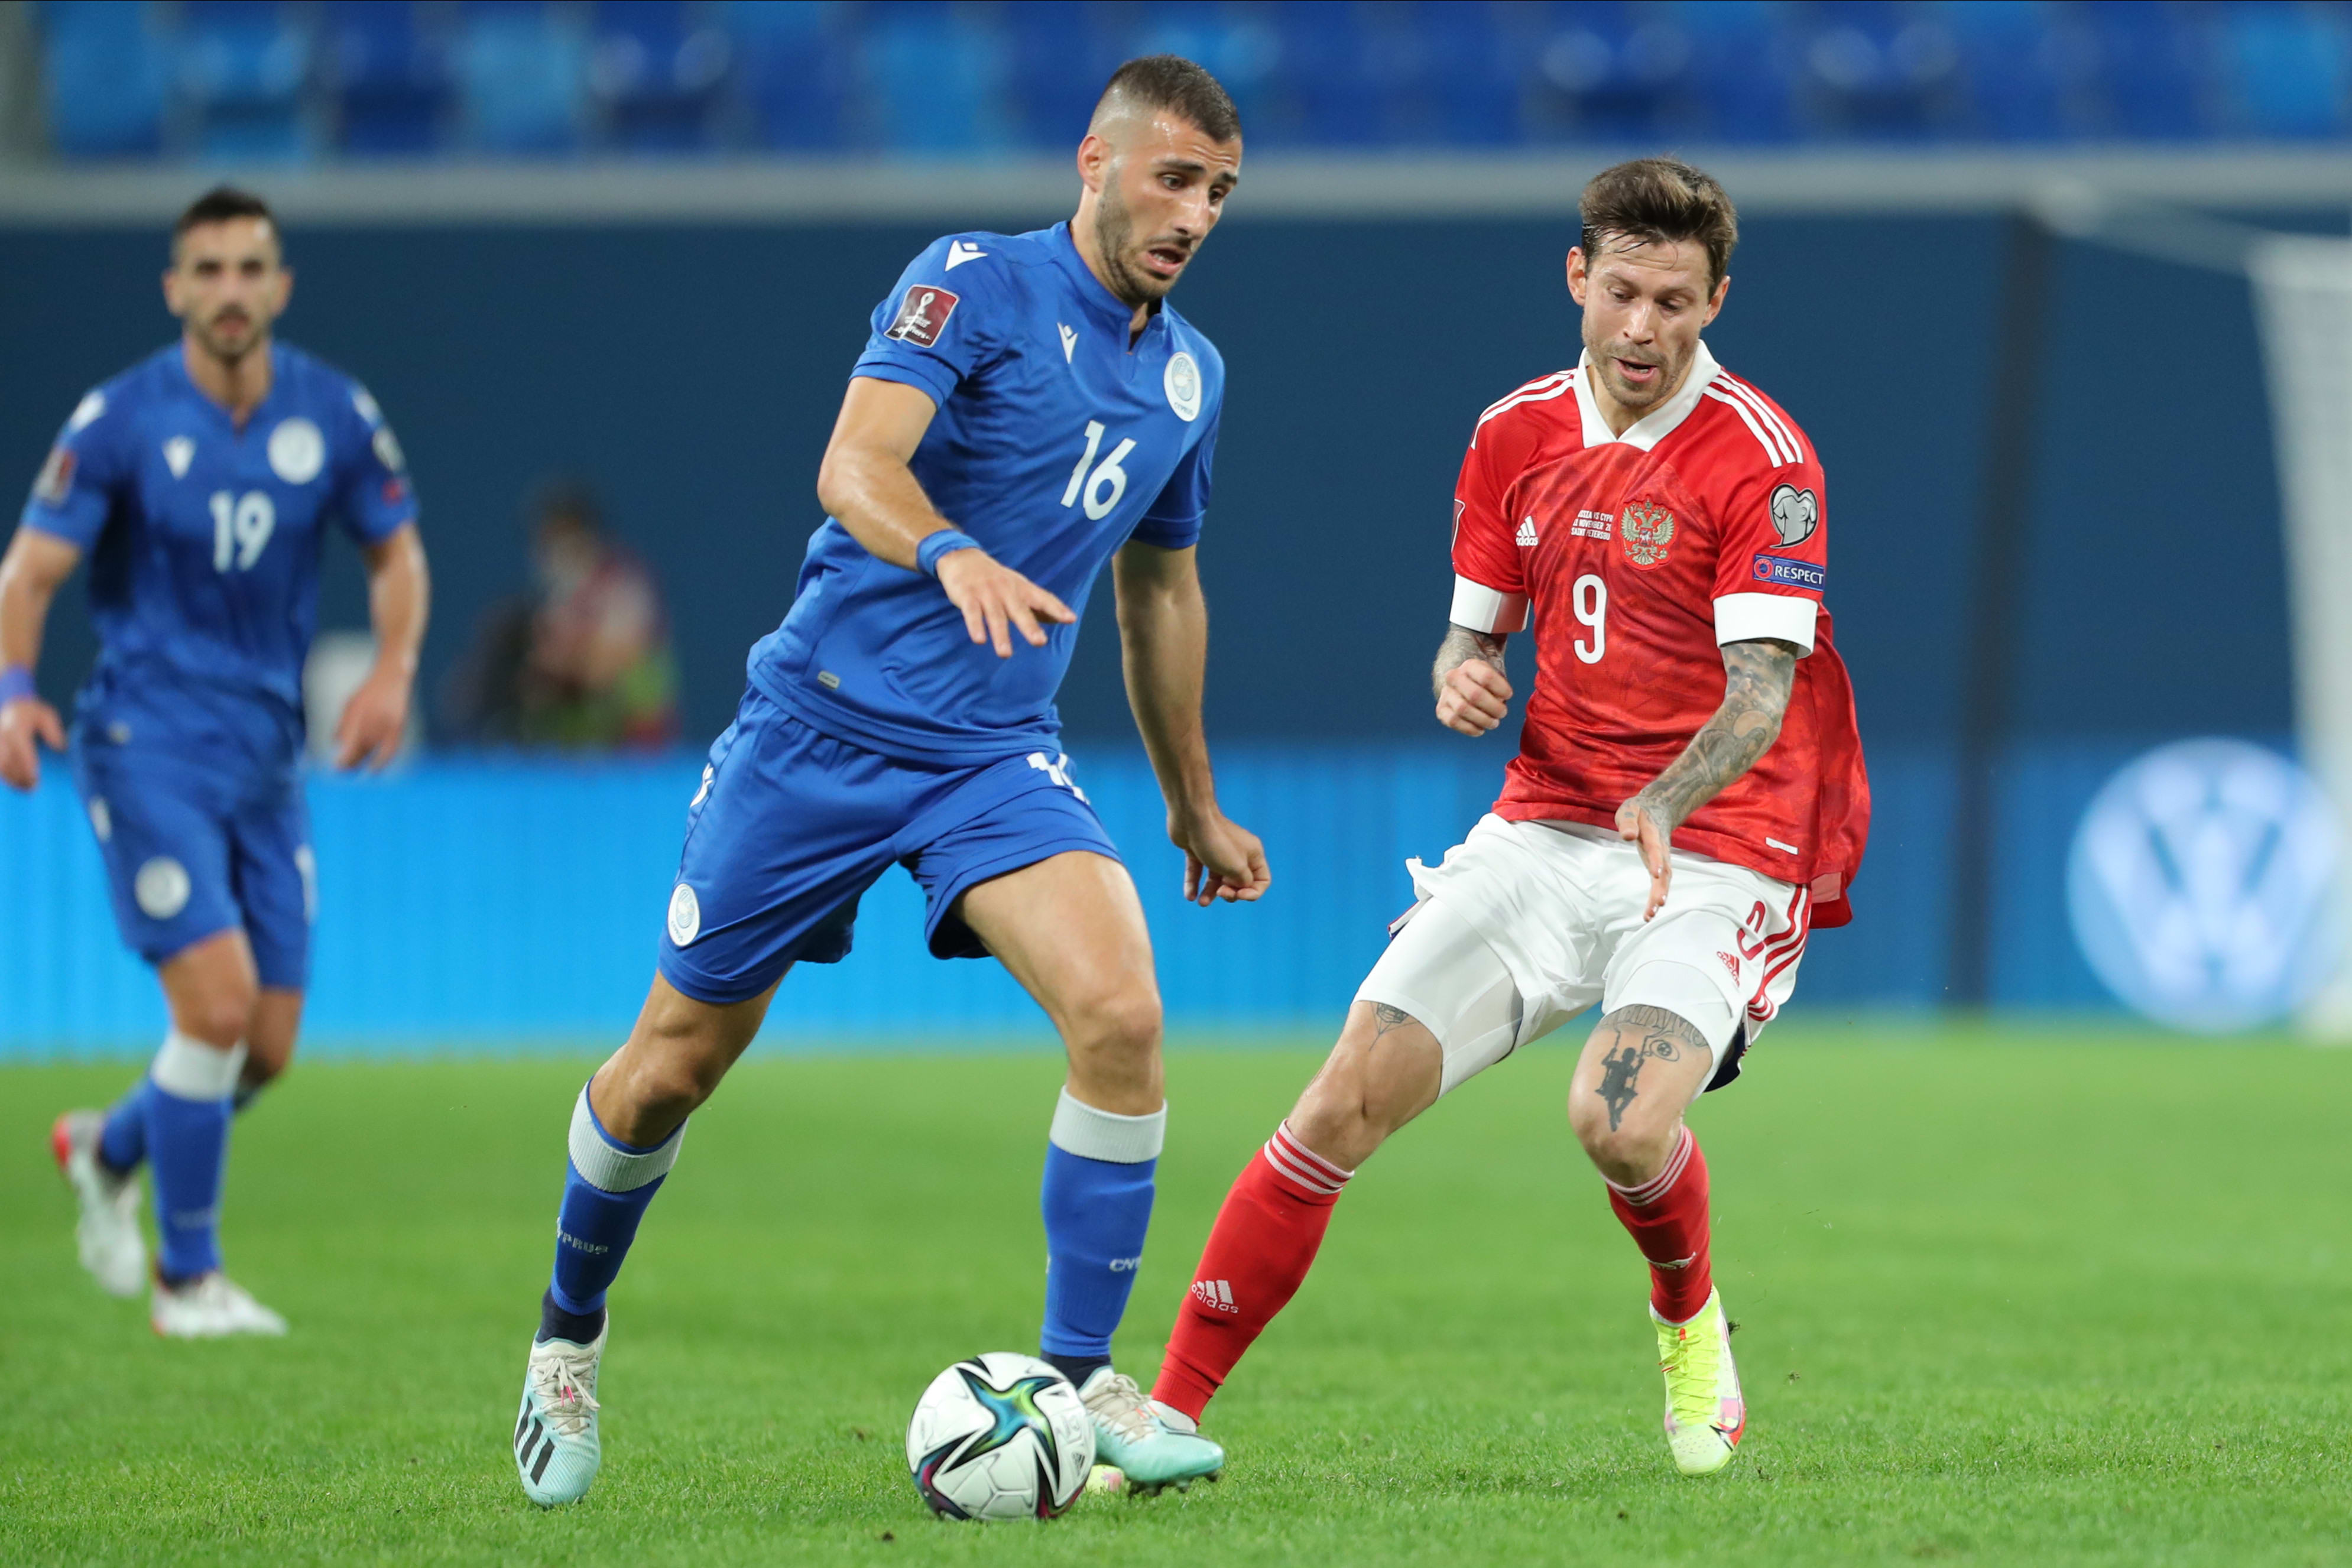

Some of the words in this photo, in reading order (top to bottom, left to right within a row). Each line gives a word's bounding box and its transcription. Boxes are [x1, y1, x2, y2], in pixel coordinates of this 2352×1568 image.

[1060, 419, 1137, 521] 16
[209, 489, 275, 573] 19
[1516, 535, 1539, 547] adidas
[1774, 565, 1825, 585] RESPECT
[1573, 574, 1607, 664] 9
[1191, 1284, 1239, 1313] adidas
